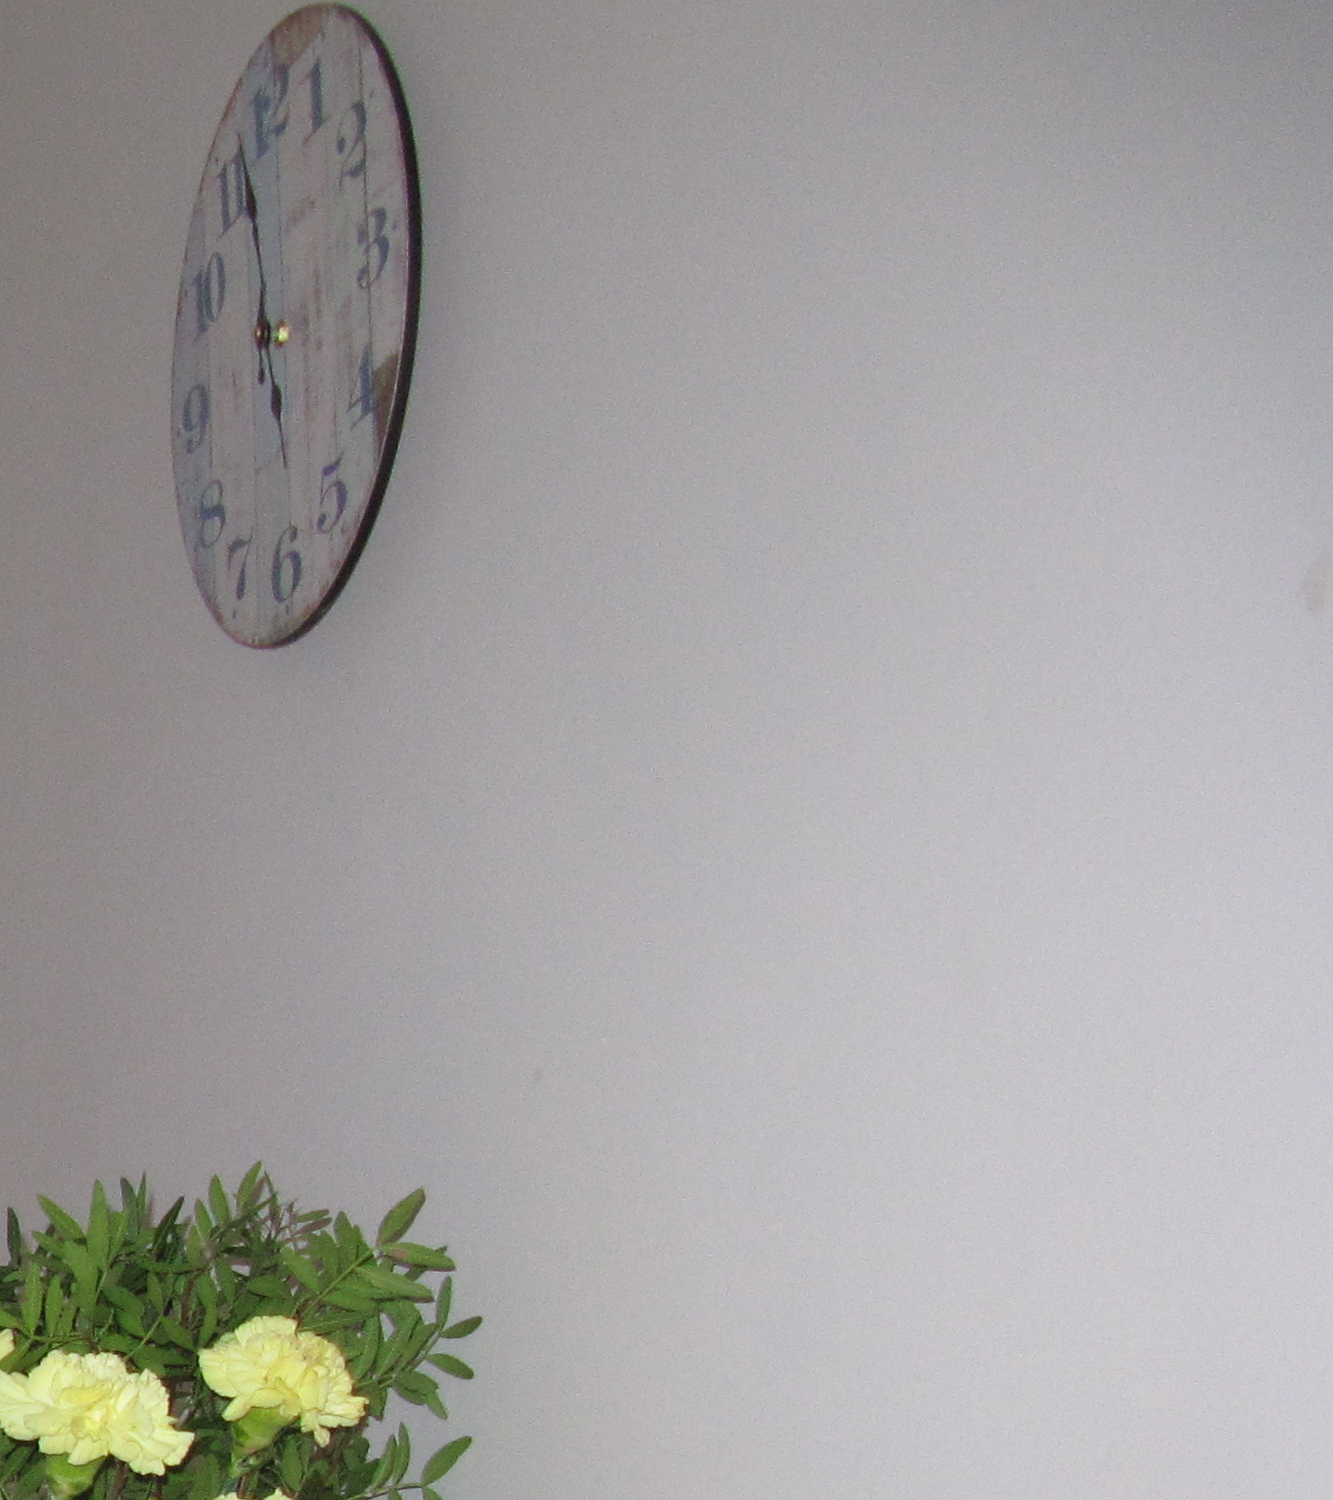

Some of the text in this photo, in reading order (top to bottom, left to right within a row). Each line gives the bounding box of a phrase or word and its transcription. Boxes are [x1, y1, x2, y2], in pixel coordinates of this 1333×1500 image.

[251, 64, 289, 160] 12
[303, 60, 329, 140] 1
[335, 101, 367, 190] 2
[356, 207, 390, 289] 3
[194, 253, 225, 339] 10
[181, 384, 209, 454] 9
[347, 343, 374, 430] 4
[196, 479, 226, 549] 8
[316, 451, 348, 534] 5
[227, 530, 253, 602] 7
[271, 524, 303, 603] 6
